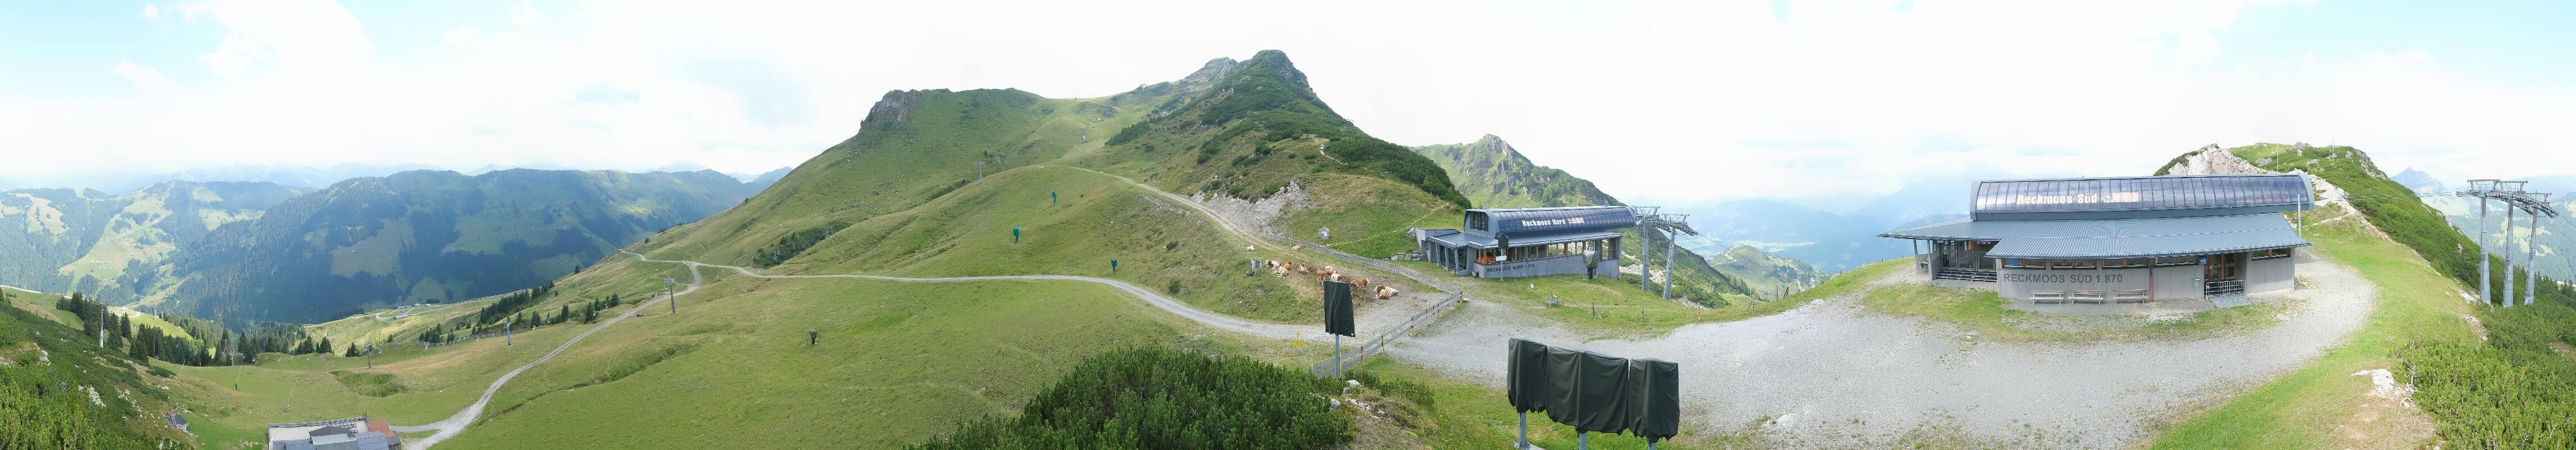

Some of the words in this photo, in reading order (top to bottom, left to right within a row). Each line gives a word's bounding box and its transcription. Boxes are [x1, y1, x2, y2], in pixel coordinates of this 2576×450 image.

[2017, 194, 2073, 204] Reckmoos
[2077, 192, 2097, 203] Süd
[2003, 273, 2065, 283] RECKMOOS
[2070, 273, 2092, 283] SÜD
[2096, 274, 2123, 283] 1.870
